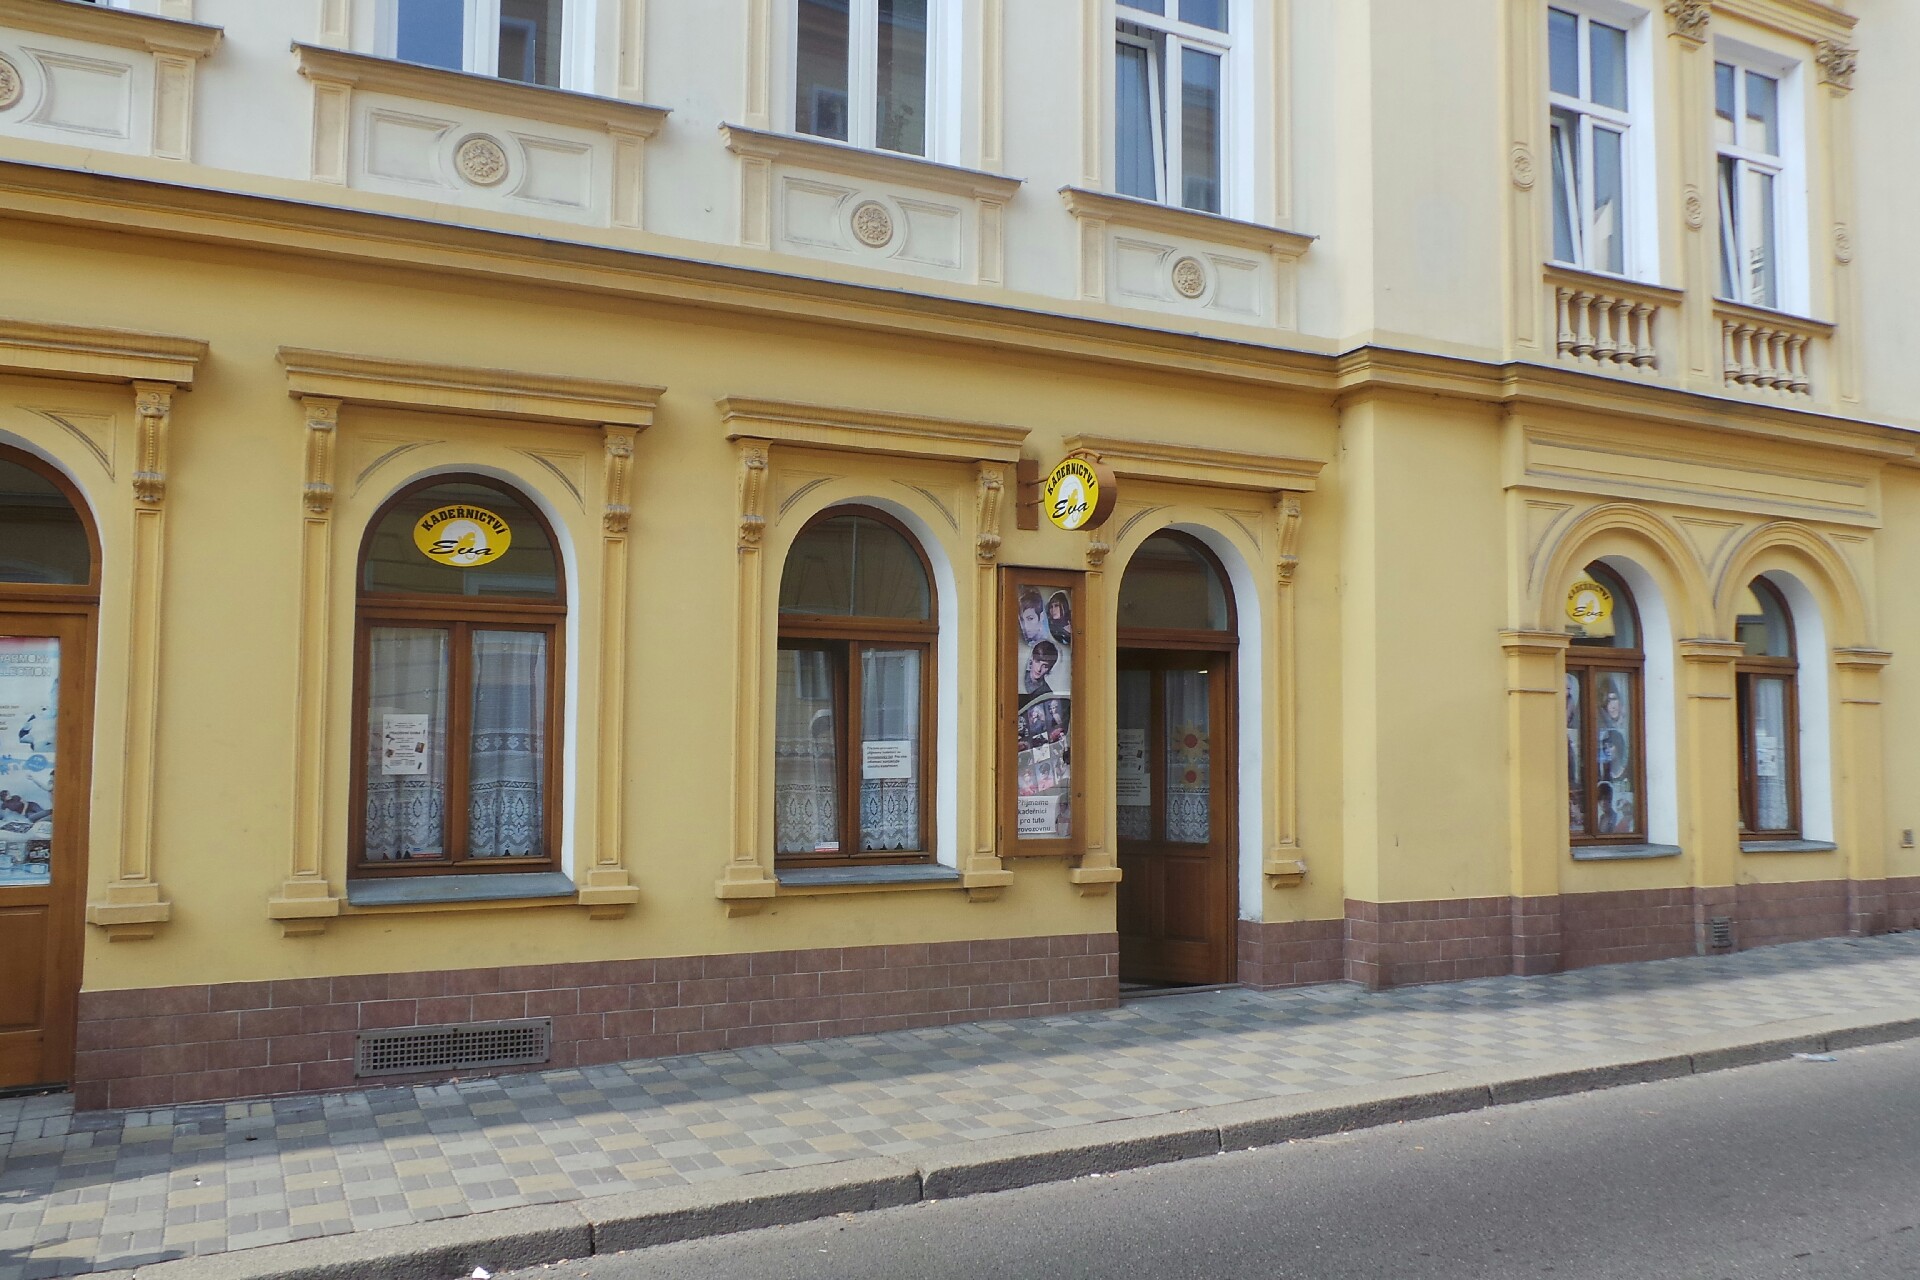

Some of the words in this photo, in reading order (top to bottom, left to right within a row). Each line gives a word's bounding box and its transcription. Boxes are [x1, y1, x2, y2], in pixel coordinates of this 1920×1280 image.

[1047, 461, 1096, 496] KADEŘNICTVÍ
[1052, 499, 1089, 518] Eva
[421, 506, 508, 535] KADEŘNICTVÍ
[428, 540, 493, 555] Eva
[1573, 606, 1604, 617] Eva
